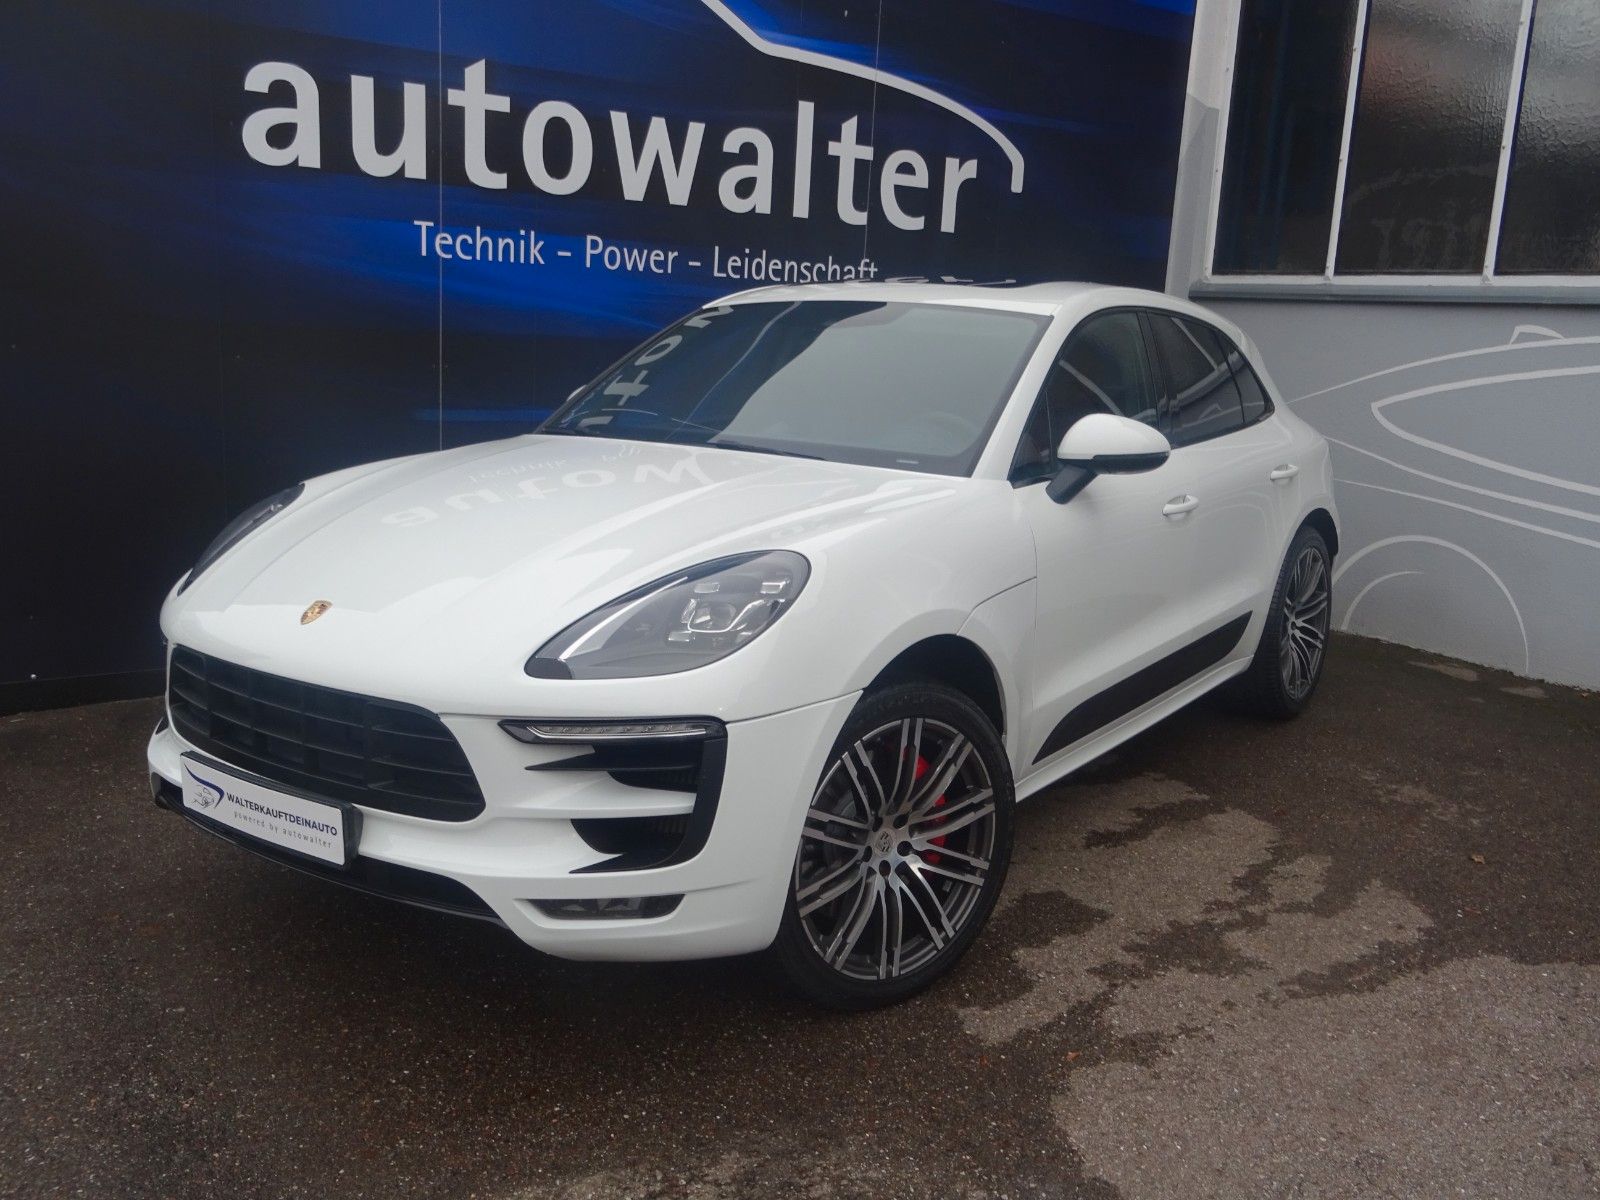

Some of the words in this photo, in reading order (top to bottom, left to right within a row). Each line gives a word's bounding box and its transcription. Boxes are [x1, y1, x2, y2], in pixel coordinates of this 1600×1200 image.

[240, 58, 980, 235] autowalter
[413, 220, 546, 265] Technik
[585, 235, 679, 274] Power
[713, 245, 879, 283] Leidenschaft
[226, 792, 338, 836] WALTERKAUFTDEINAUTO
[233, 811, 265, 827] powered
[269, 824, 279, 834] by
[282, 828, 332, 849] autowalter
